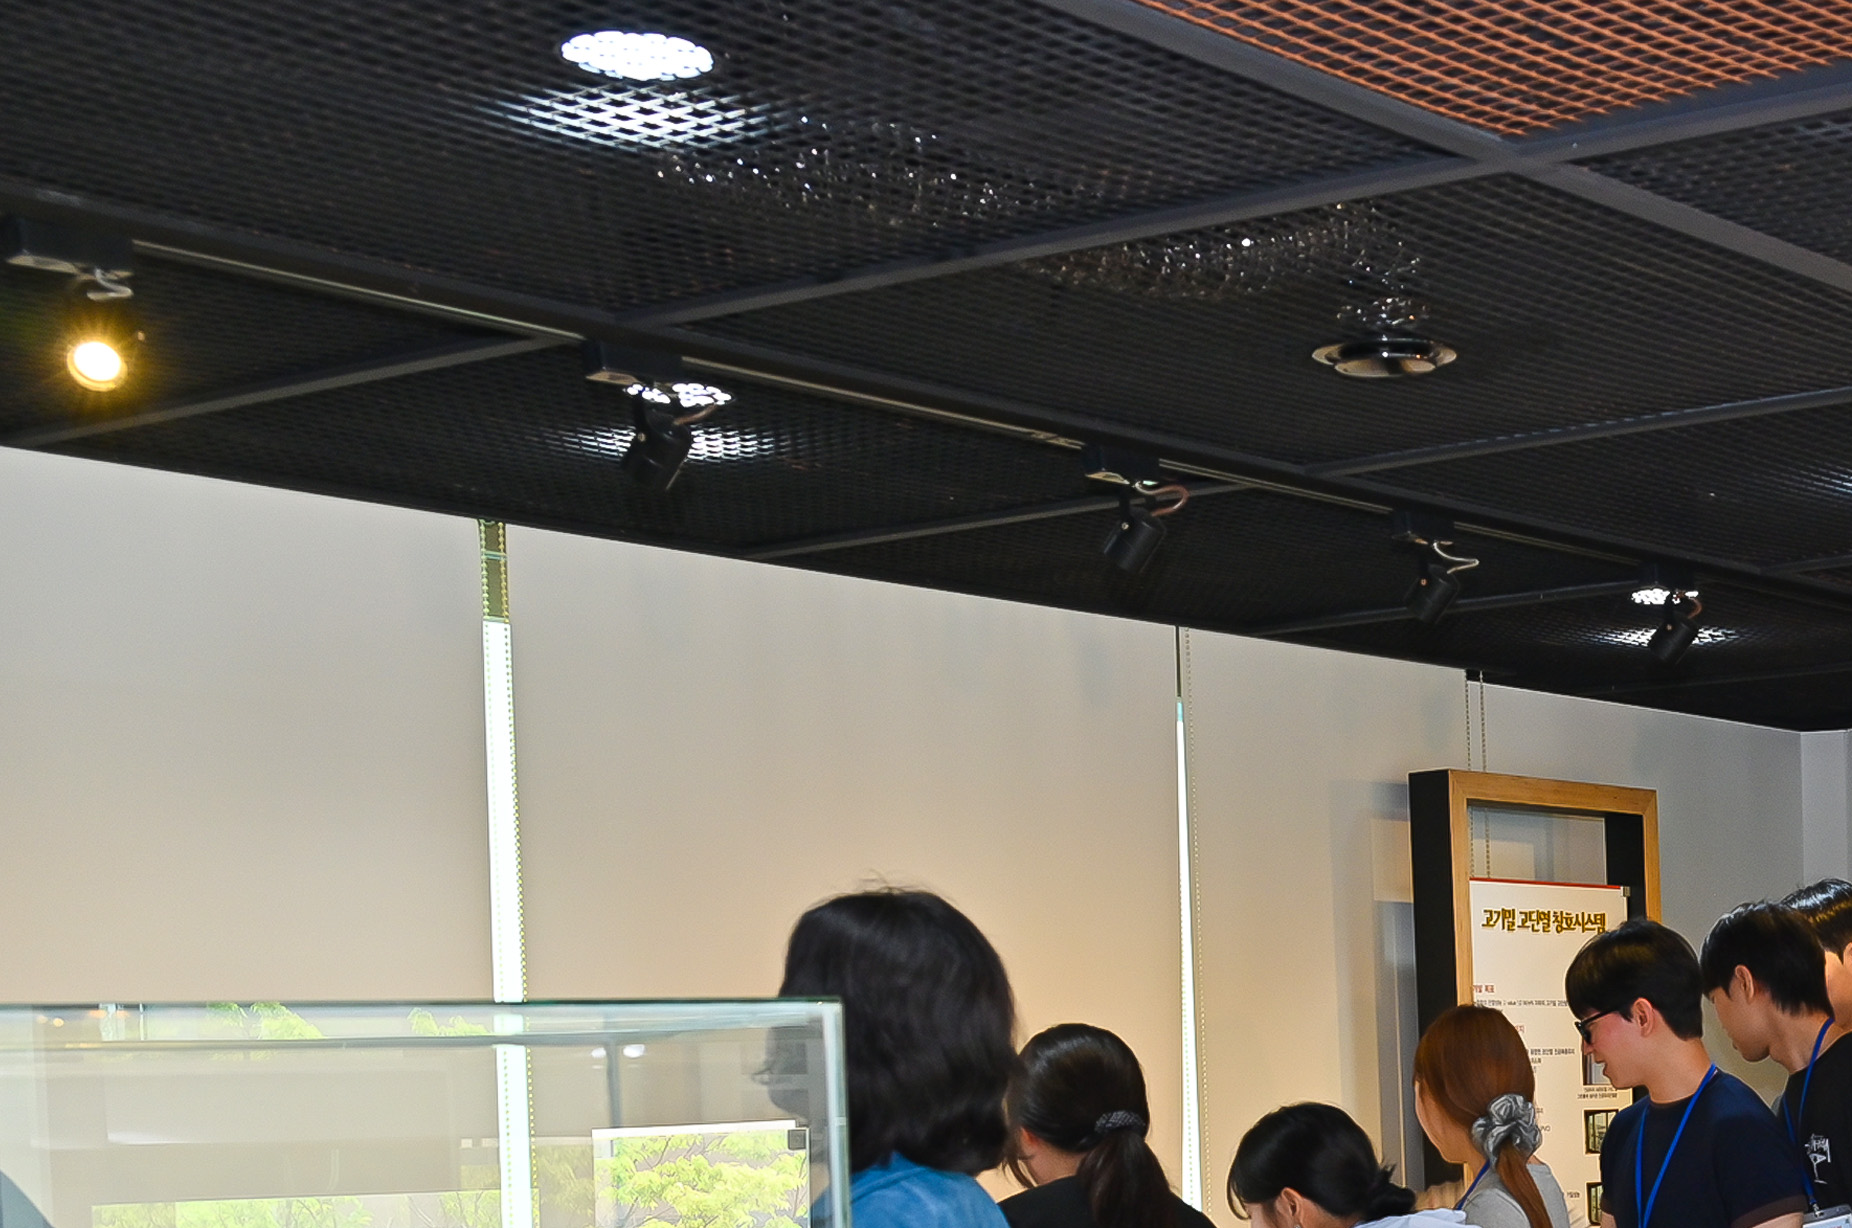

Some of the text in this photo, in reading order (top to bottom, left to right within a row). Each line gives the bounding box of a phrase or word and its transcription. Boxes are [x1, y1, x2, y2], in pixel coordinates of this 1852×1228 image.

[1481, 908, 1606, 935] 고기밀 고단열 창호시스템
